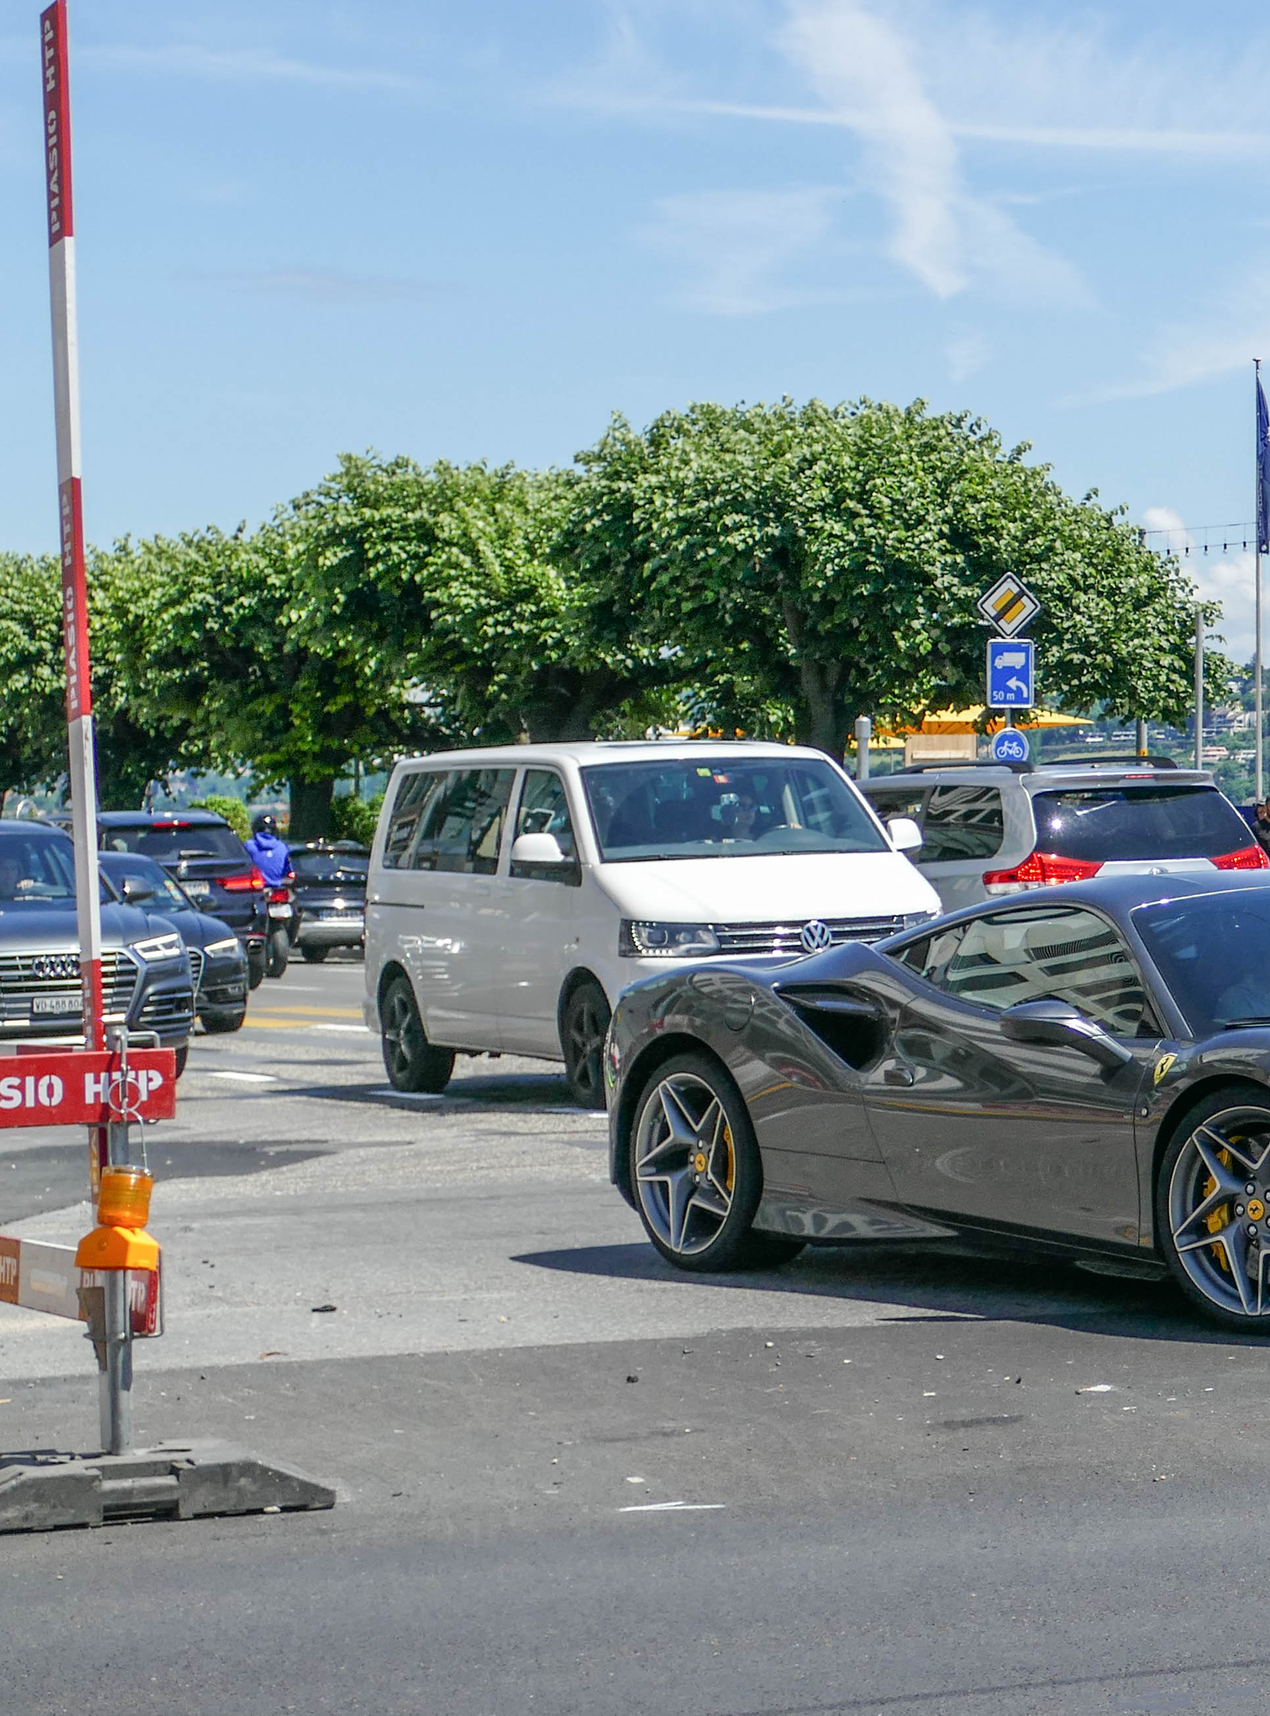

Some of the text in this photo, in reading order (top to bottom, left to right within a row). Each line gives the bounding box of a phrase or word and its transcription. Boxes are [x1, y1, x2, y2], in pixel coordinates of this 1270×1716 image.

[43, 18, 61, 233] PIASIO HTP
[61, 493, 79, 710] PIASIO HTP
[992, 690, 1015, 701] 50 m
